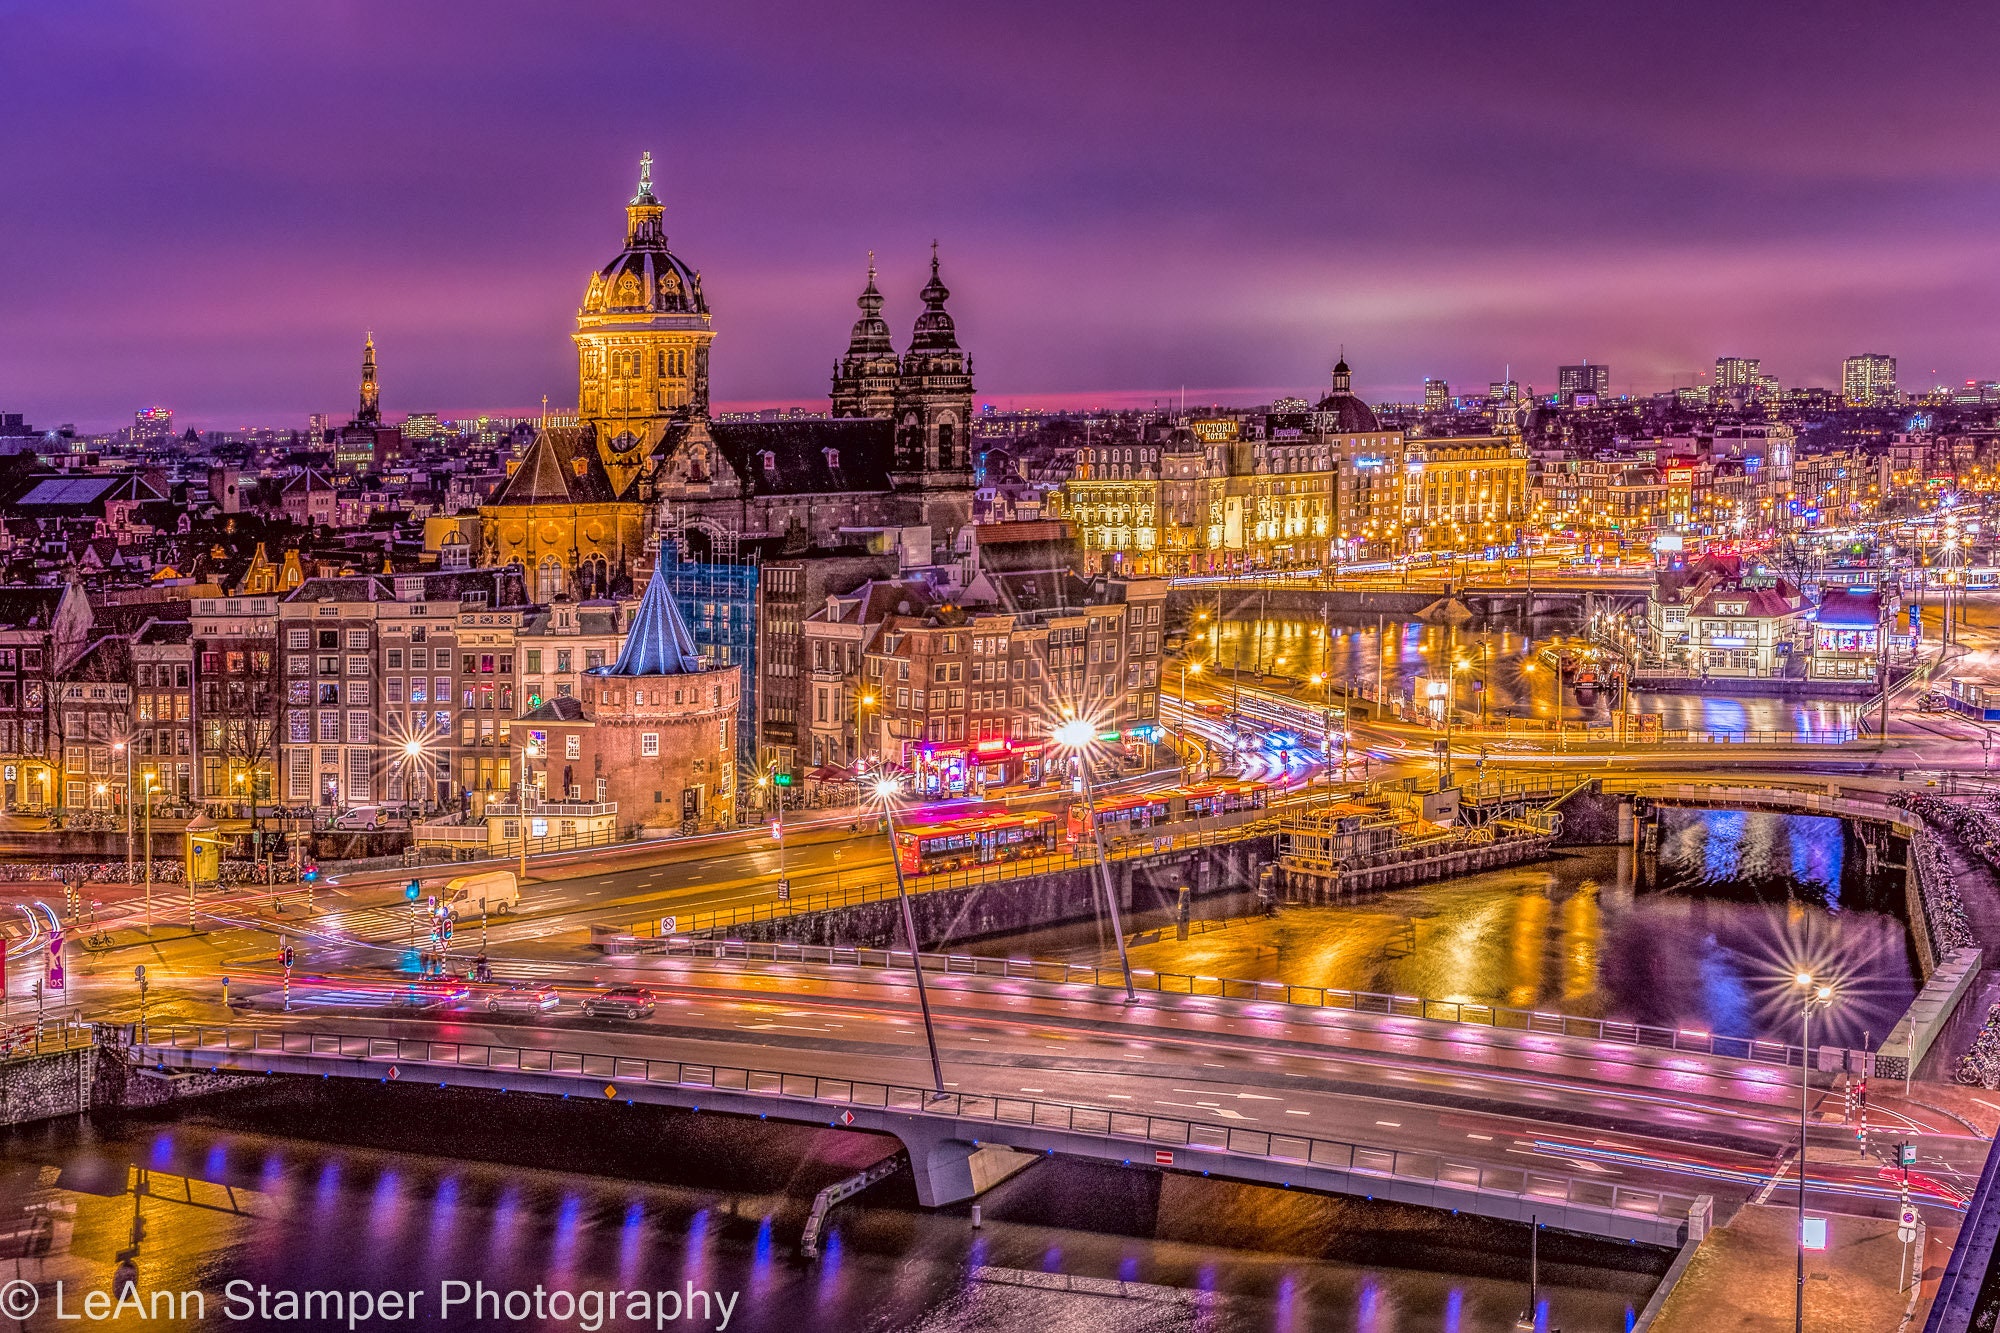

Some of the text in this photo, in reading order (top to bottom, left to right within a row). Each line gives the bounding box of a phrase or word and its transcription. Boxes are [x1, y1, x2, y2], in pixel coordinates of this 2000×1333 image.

[1196, 422, 1237, 433] VICTORIA
[1273, 427, 1302, 437] Travelex
[1205, 432, 1228, 440] HOTEL
